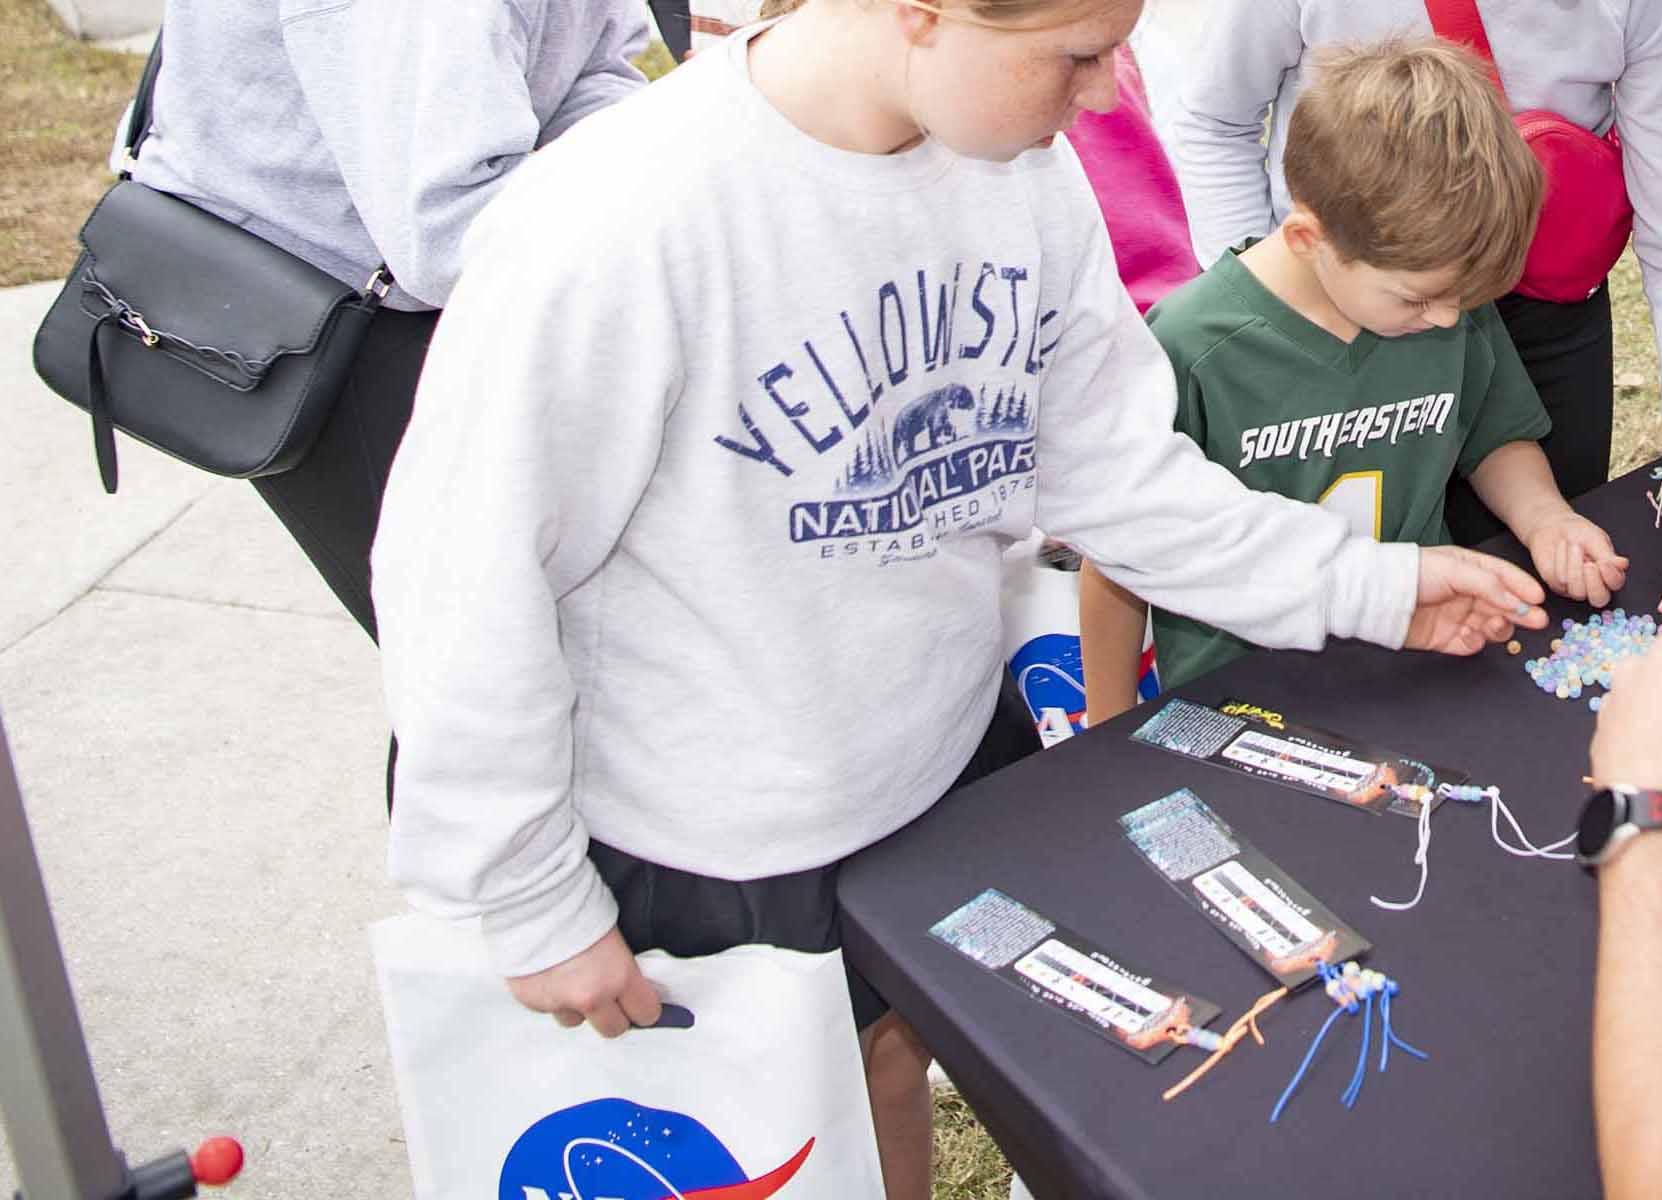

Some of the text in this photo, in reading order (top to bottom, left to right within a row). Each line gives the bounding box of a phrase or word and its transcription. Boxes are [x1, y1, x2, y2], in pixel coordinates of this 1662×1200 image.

[1240, 393, 1455, 469] SOUTHEASTERN
[793, 455, 963, 541] NATIOAL
[970, 441, 1037, 488] PAR
